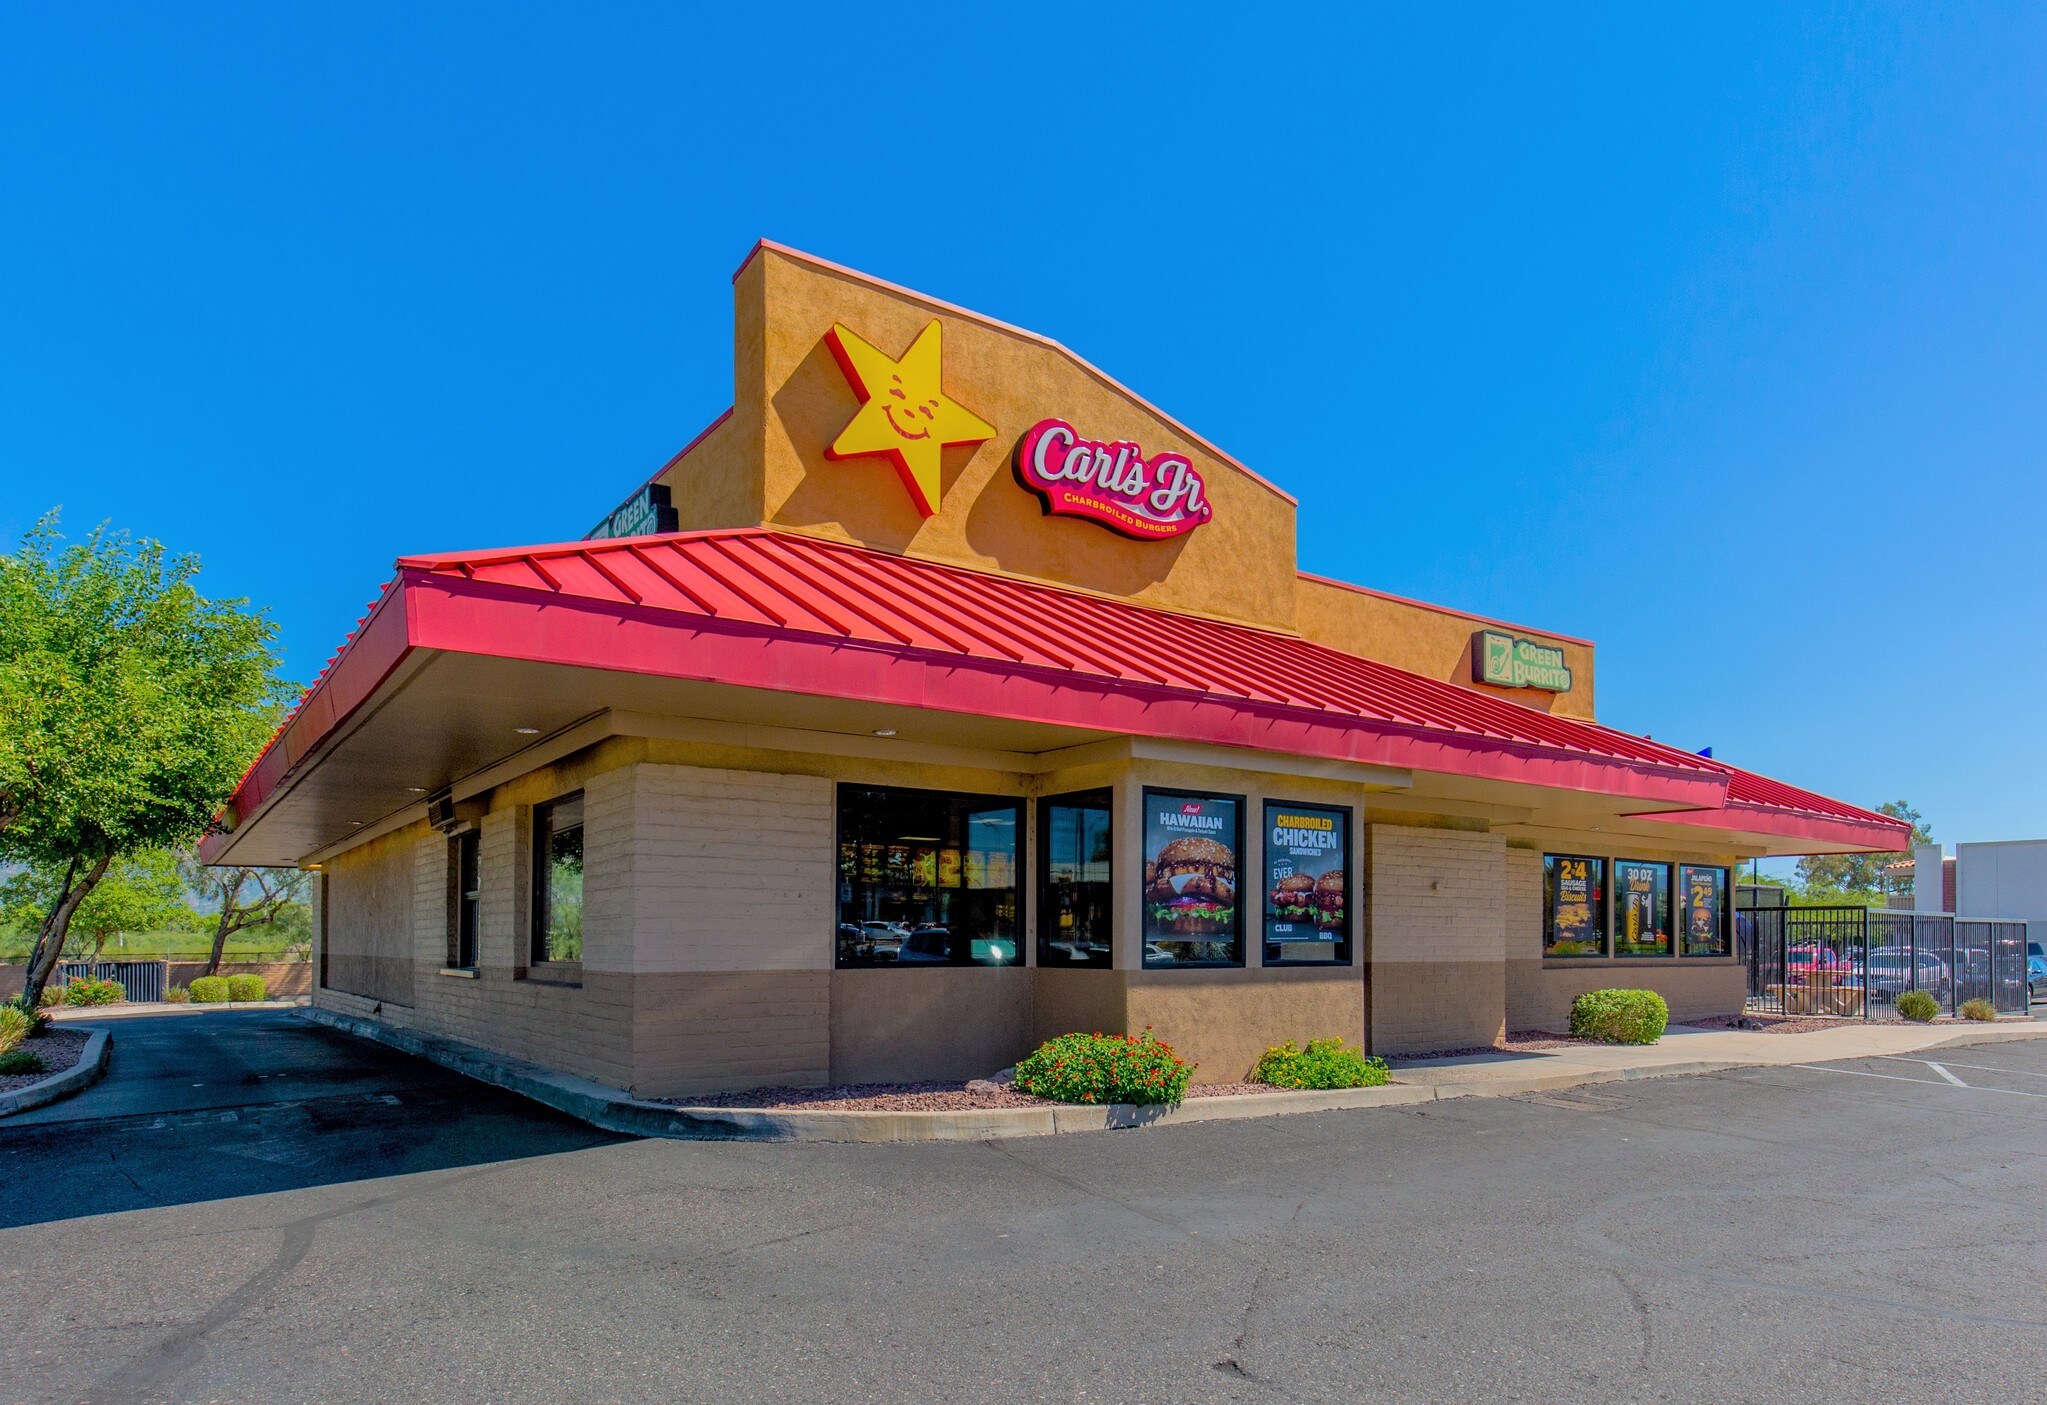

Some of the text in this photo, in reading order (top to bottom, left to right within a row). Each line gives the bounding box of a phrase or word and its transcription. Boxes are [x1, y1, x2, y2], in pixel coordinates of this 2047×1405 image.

[1034, 427, 1209, 516] Carl's Jr.
[613, 486, 649, 538] GREEN
[1064, 492, 1177, 533] CHARBROILED BURGERS
[1519, 641, 1563, 668] GREEN
[1160, 812, 1223, 830] HAWAIIAN
[1277, 814, 1333, 831] CHARBROILED
[1272, 827, 1337, 849] CHICKEN
[1289, 846, 1322, 856] SANDWICHES
[1273, 867, 1293, 880] EVER
[1560, 859, 1572, 880] 2
[1627, 868, 1653, 882] 30 OZ
[1560, 879, 1587, 887] SAUSAGE
[1275, 924, 1293, 932] CLUB
[1319, 932, 1333, 940] BBQ
